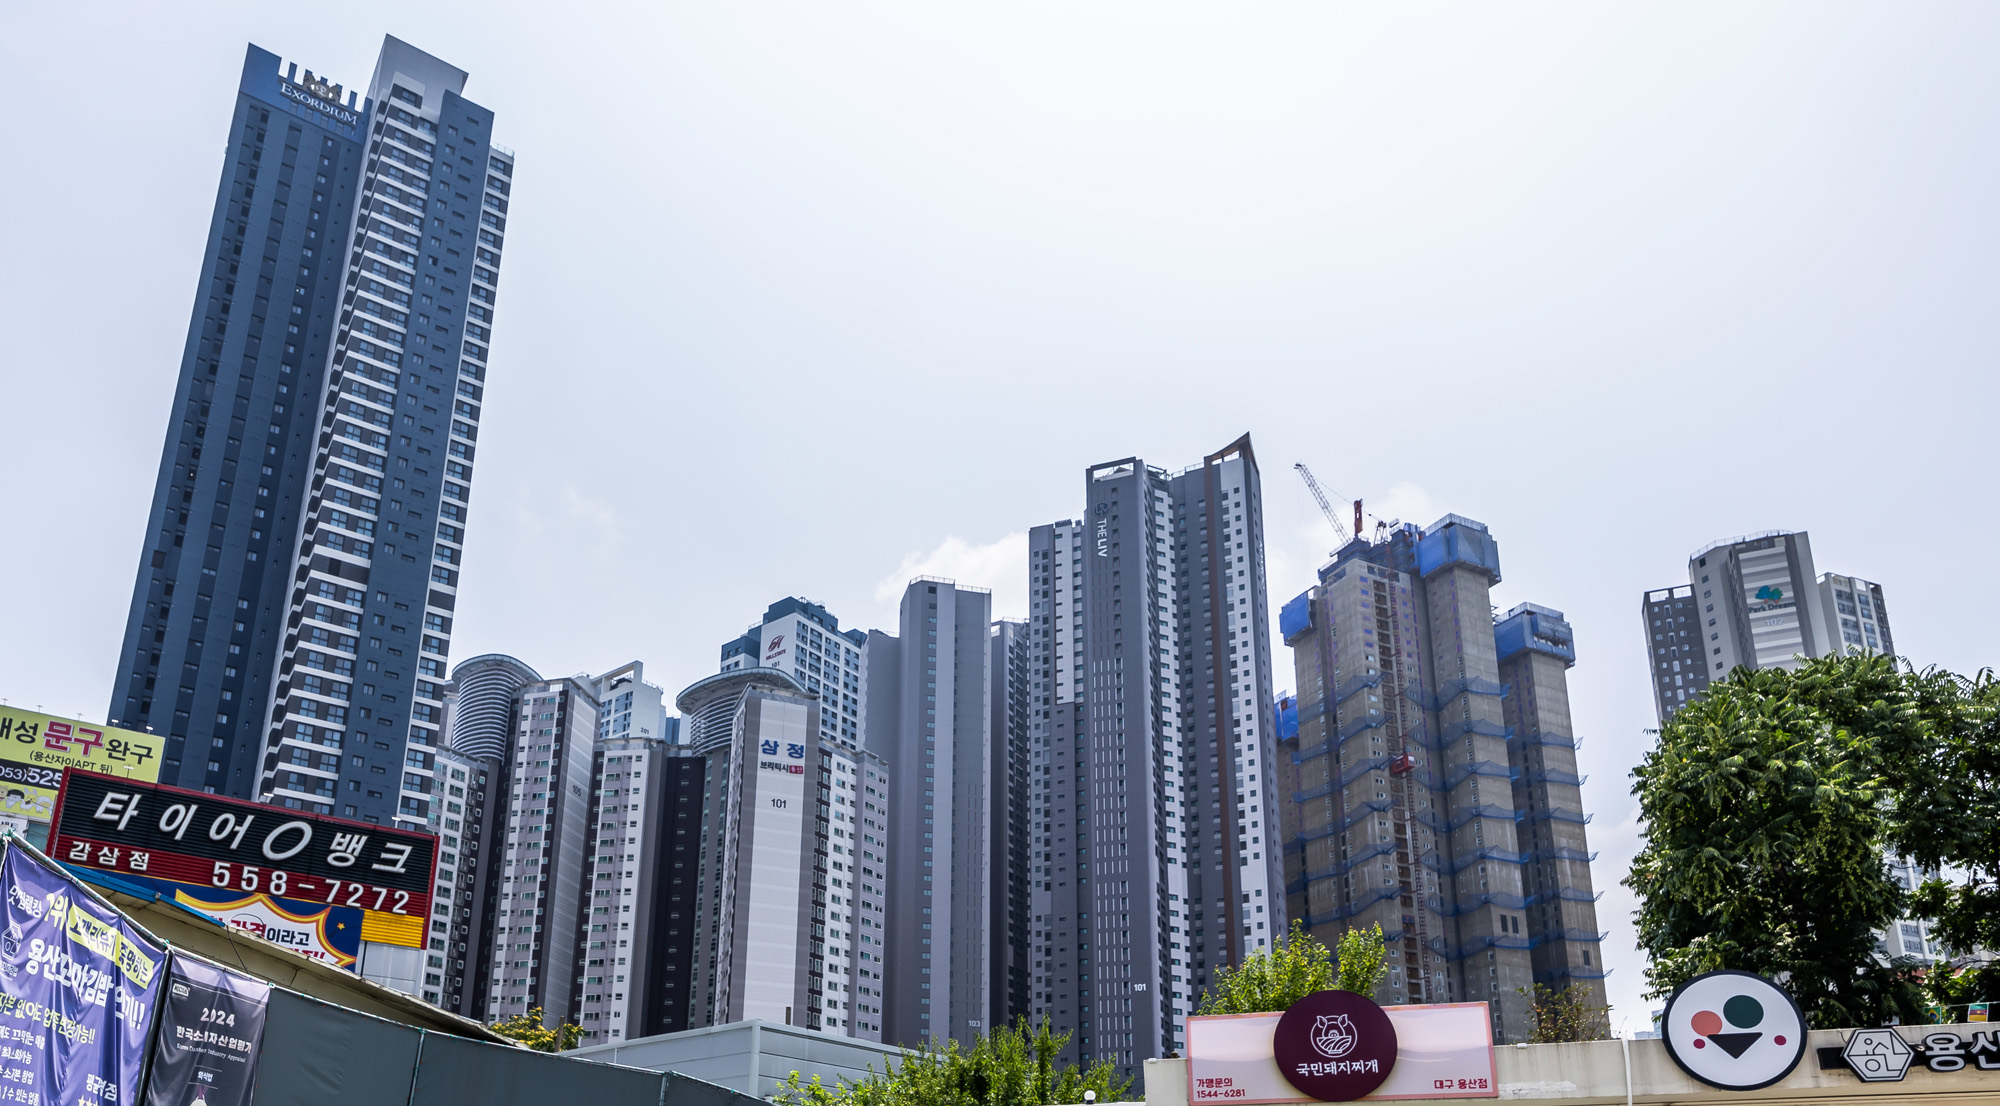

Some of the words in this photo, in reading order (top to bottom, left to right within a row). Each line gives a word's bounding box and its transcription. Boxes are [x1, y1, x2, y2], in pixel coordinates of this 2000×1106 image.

[1766, 617, 1784, 627] 102
[572, 784, 582, 797] 105
[771, 798, 787, 809] 101
[69, 841, 150, 871] 감삼점
[212, 861, 410, 915] 558-7272
[1133, 982, 1147, 992] 101
[200, 1007, 236, 1028] 2024
[968, 1019, 981, 1028] 103
[1296, 1059, 1379, 1077] 국민돼지찌개
[1196, 1077, 1232, 1088] 가맹문의
[1434, 1079, 1454, 1089] 대구
[1457, 1078, 1487, 1089] 용산점
[1196, 1089, 1245, 1099] 1544-6281
